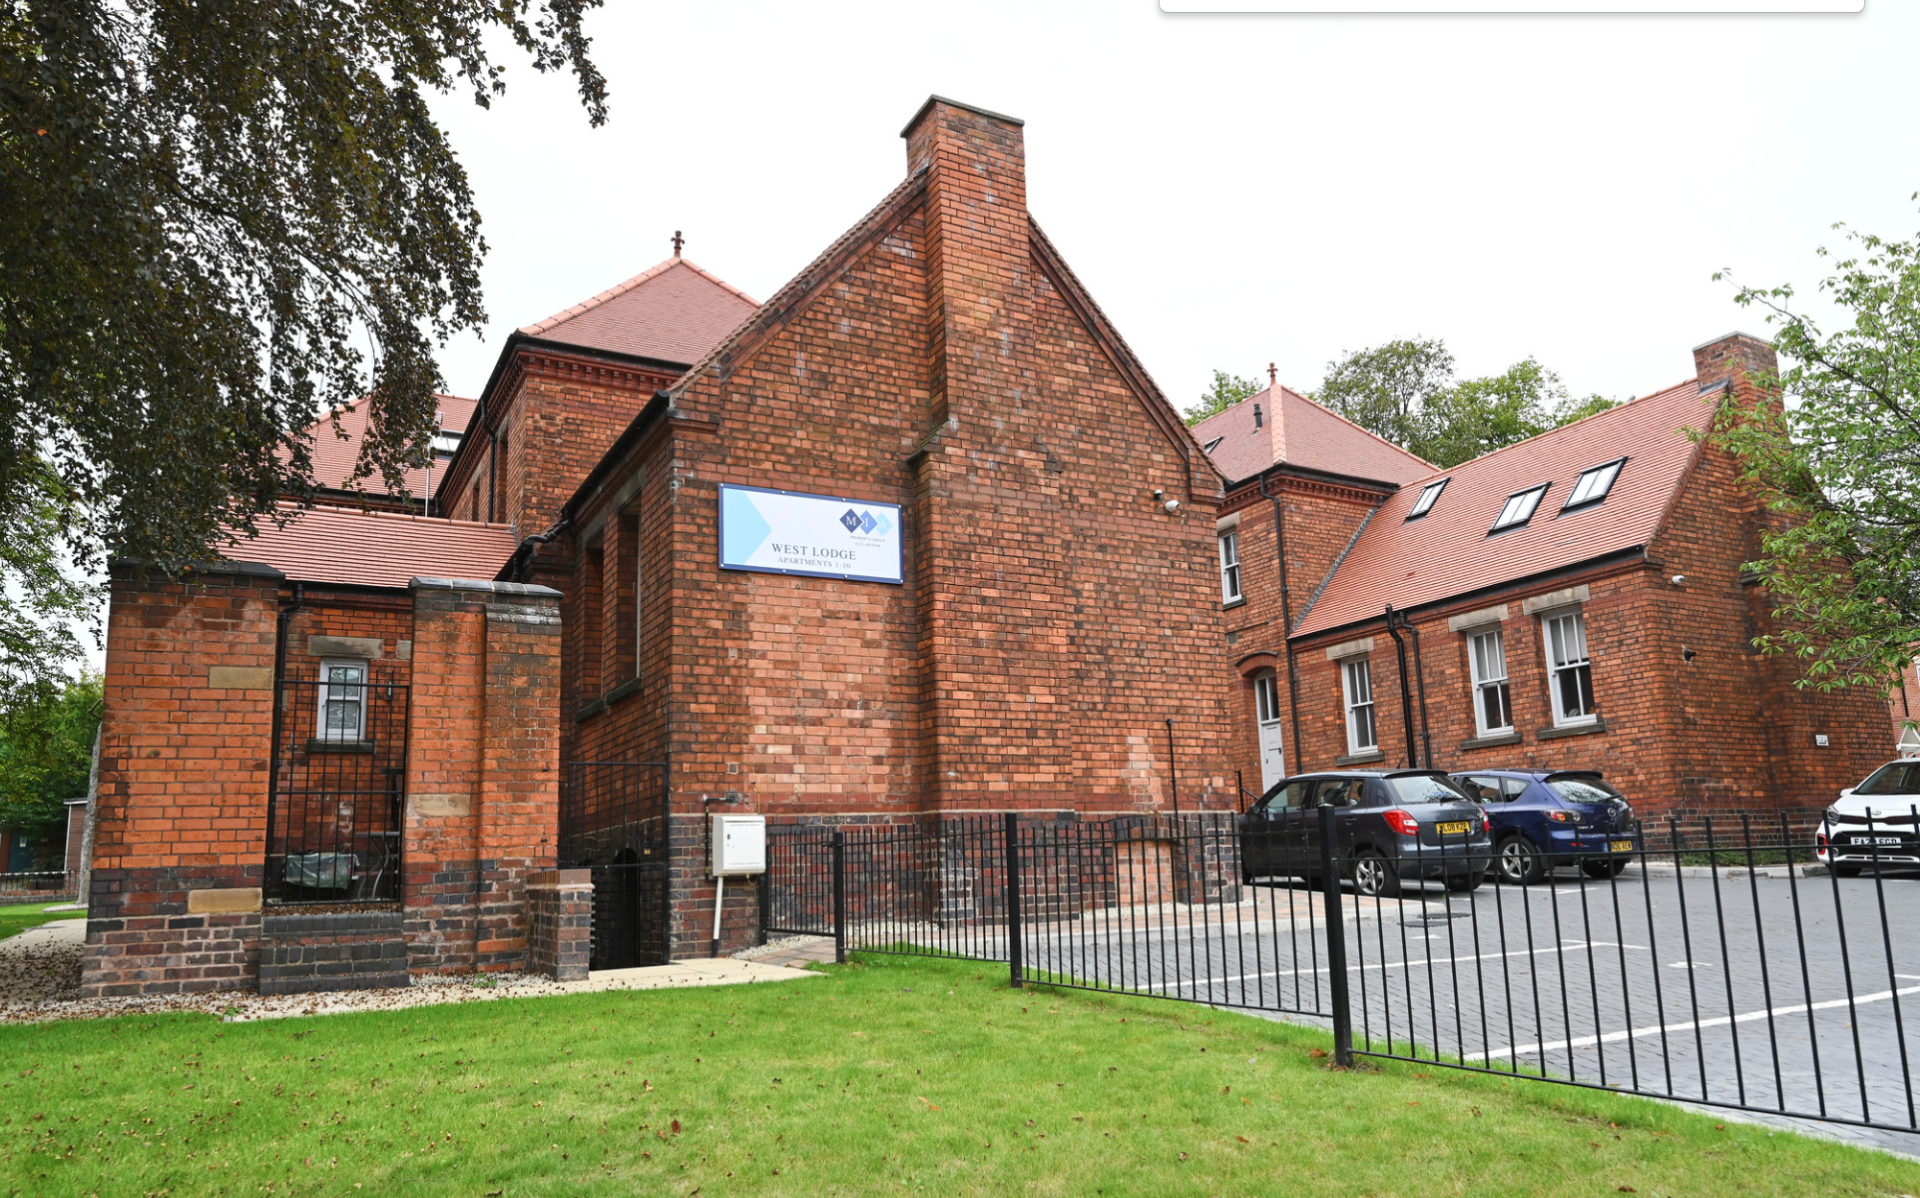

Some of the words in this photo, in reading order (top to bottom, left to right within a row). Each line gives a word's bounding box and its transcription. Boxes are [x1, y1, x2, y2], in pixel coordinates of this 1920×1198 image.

[771, 543, 808, 556] WEST
[812, 546, 857, 560] LODGE
[778, 556, 833, 568] APARTMENTS
[835, 561, 851, 569] 1-10
